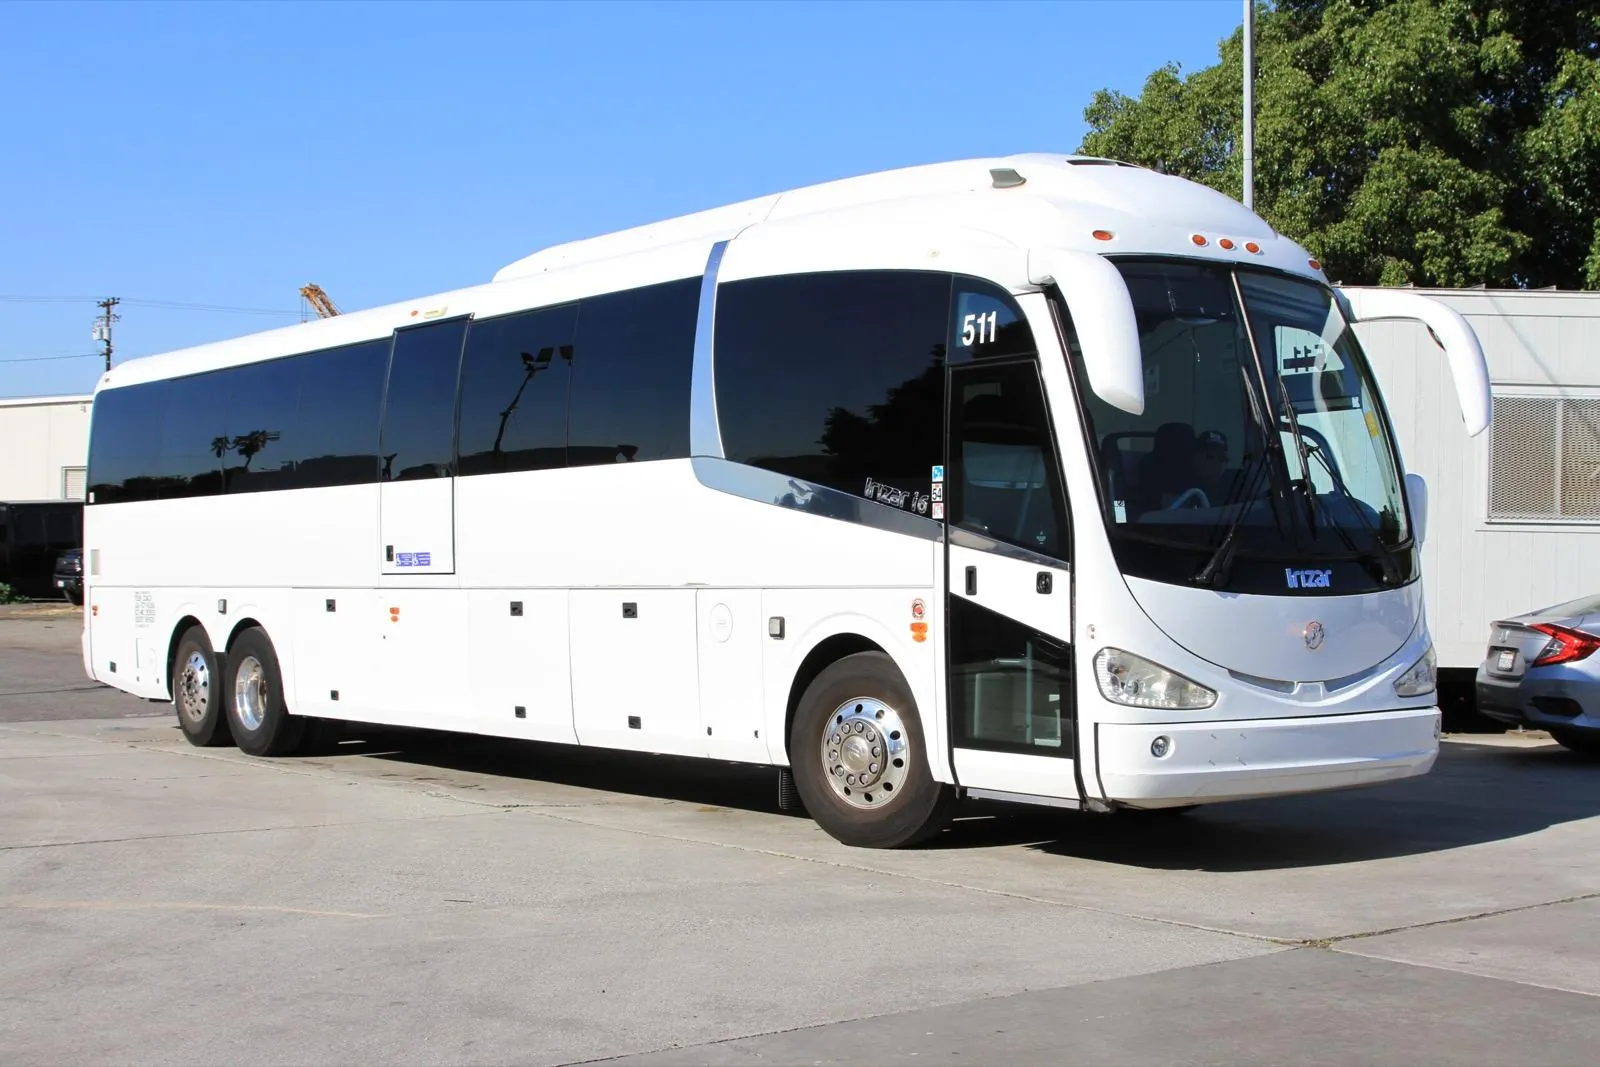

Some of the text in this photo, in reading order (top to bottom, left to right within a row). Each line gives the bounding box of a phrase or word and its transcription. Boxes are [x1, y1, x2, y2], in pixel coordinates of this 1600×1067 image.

[962, 311, 997, 346] 511
[864, 477, 910, 508] Irizar
[911, 491, 929, 514] i6
[932, 487, 942, 501] 54
[1285, 568, 1332, 588] Irizar
